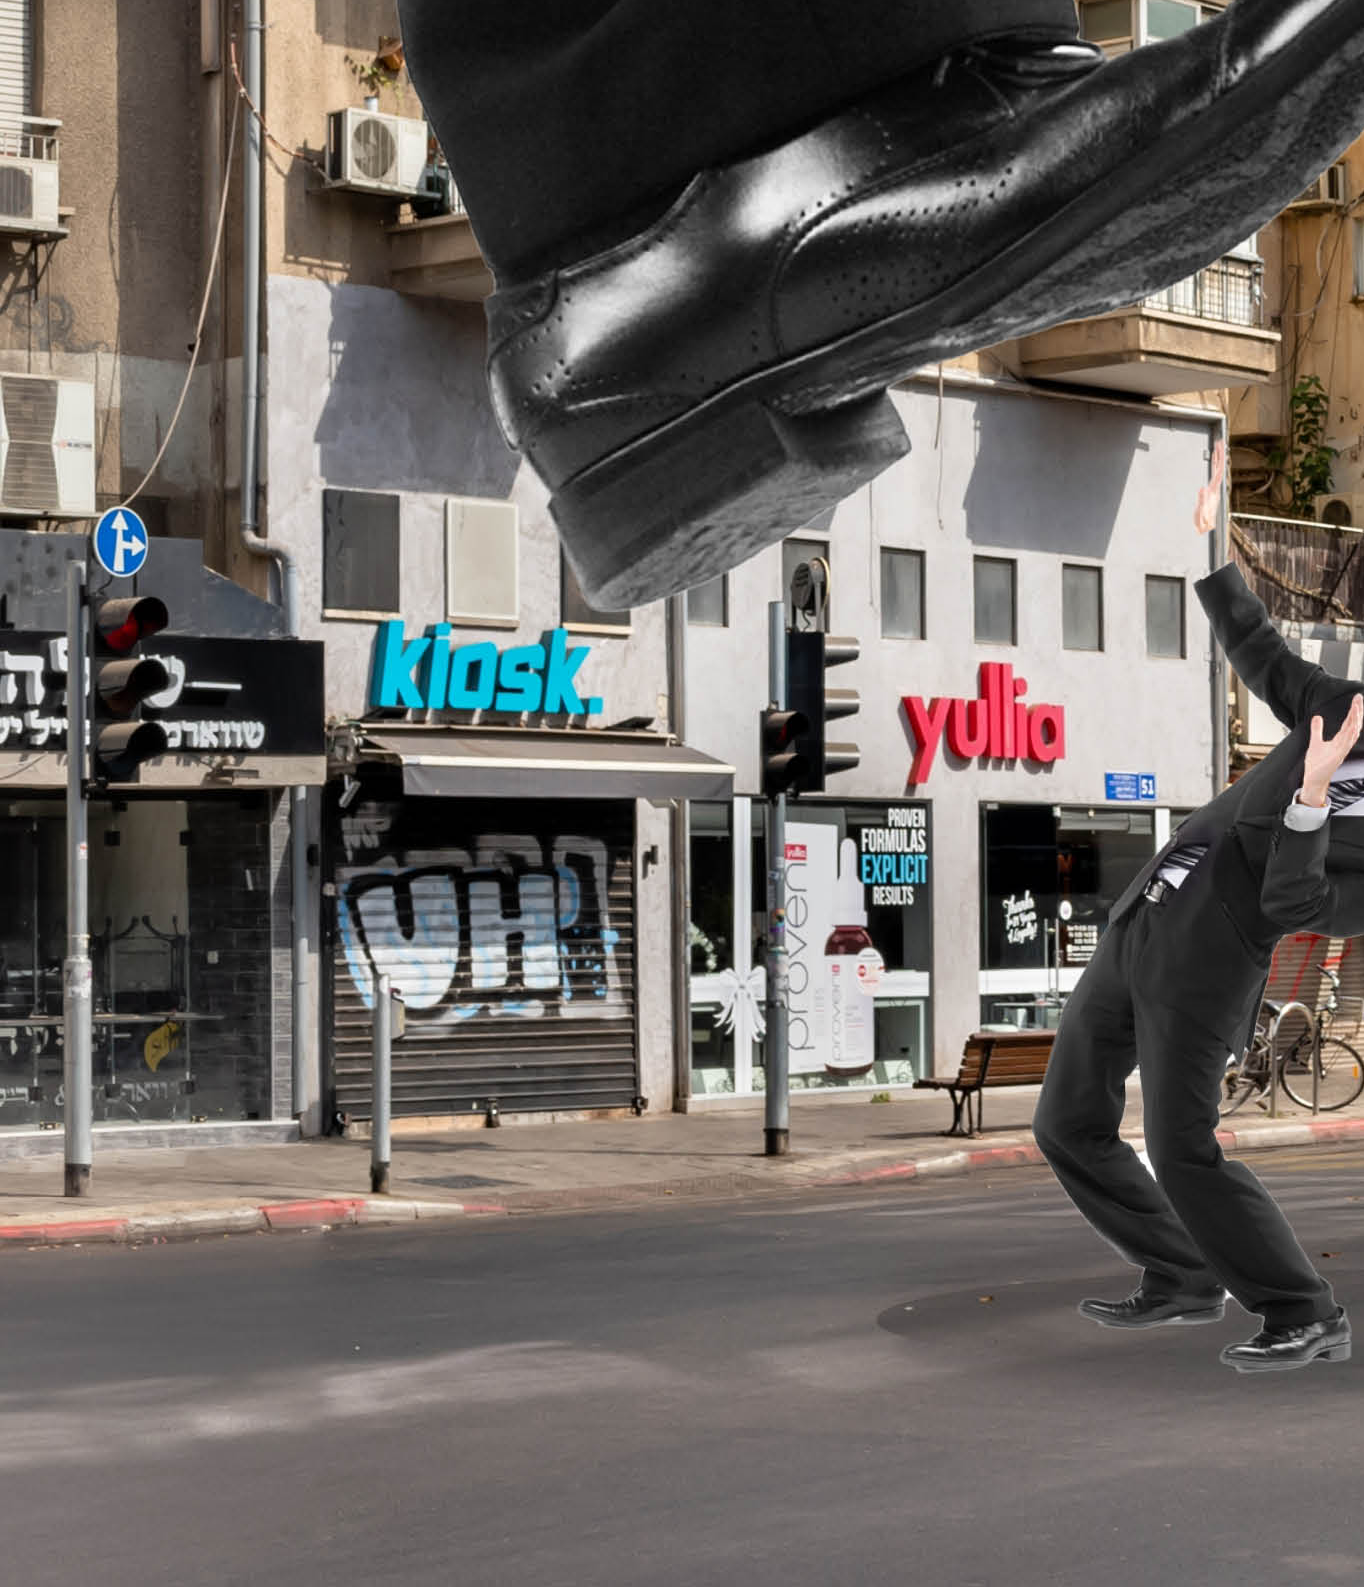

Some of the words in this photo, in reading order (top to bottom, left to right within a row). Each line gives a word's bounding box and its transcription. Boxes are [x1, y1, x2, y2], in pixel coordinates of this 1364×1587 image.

[372, 619, 604, 715] kiosk.
[140, 719, 266, 750] שווארמ
[900, 661, 1066, 784] yullia
[1141, 779, 1154, 796] 51
[888, 808, 926, 828] PROVEN
[861, 828, 926, 853] FORMULAS
[861, 854, 928, 884] EXPLICIT
[873, 885, 915, 906] RESULTS
[784, 863, 816, 1051] proven
